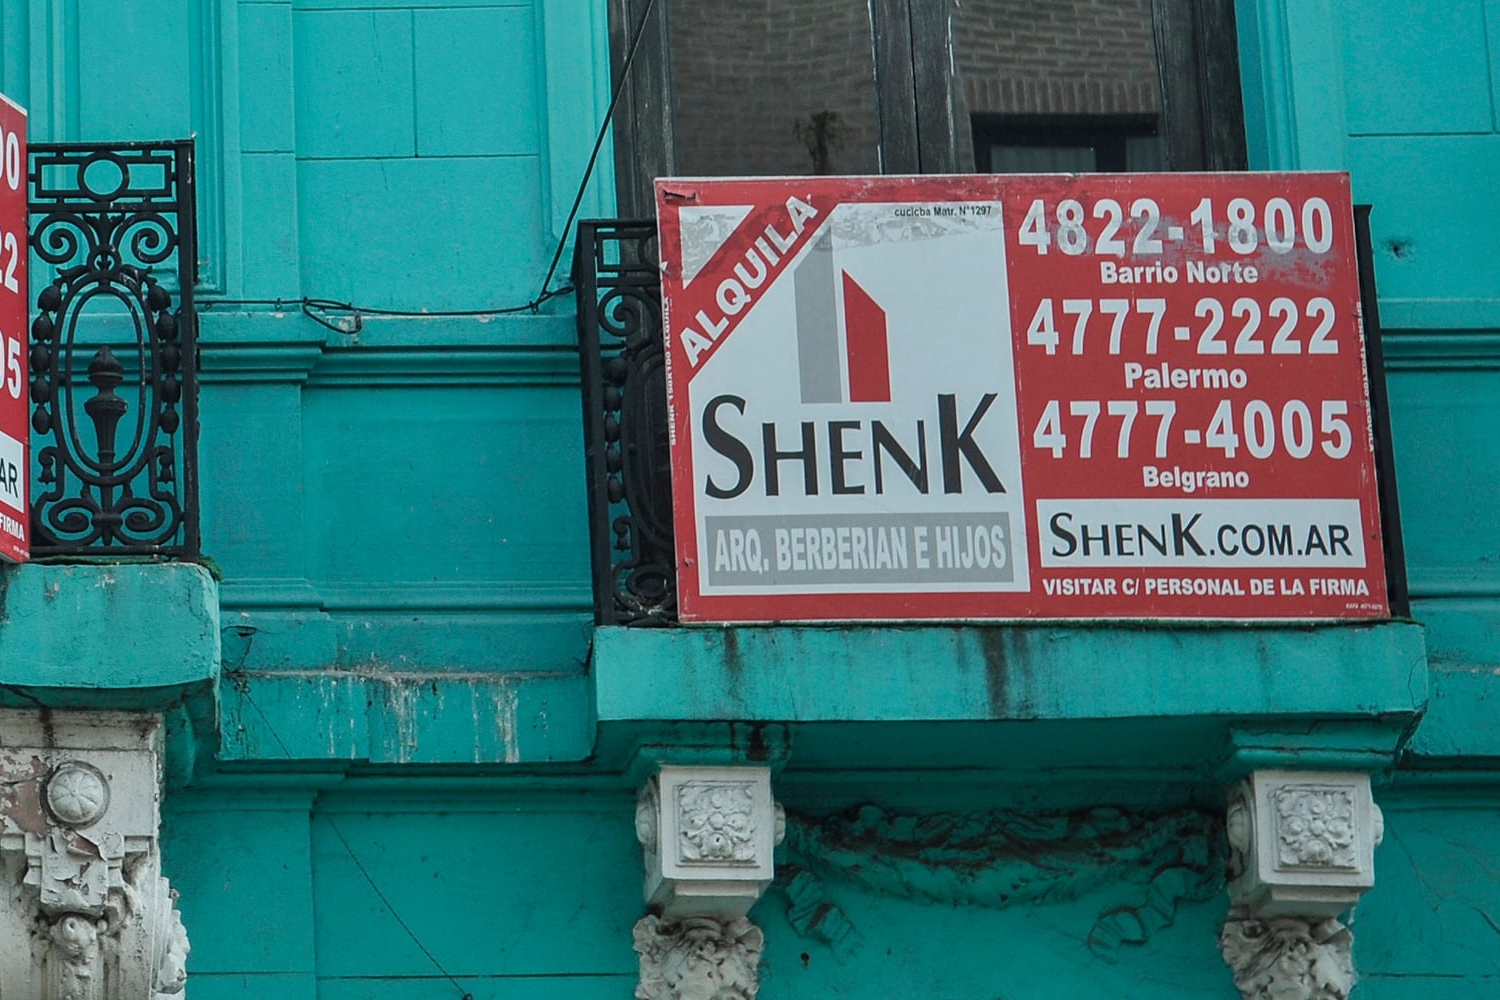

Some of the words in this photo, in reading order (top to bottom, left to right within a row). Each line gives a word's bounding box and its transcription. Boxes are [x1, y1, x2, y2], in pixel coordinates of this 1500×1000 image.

[933, 206, 956, 217] Matr.
[1018, 196, 1333, 256] 4822-1800
[680, 195, 818, 368] ALQUILA
[1100, 261, 1178, 284] Barrio
[1187, 260, 1258, 284] Norte
[1027, 297, 1339, 355] 4777-2222
[1124, 362, 1248, 389] Palermo
[702, 392, 1007, 499] SHENK
[1033, 399, 1353, 459] 4777-4005
[1143, 466, 1250, 492] Belgrano
[714, 528, 769, 575] ARQ.
[775, 526, 909, 571] BERBERIAN
[914, 526, 930, 569] E
[935, 525, 1007, 569] HIJOS
[1049, 511, 1353, 557] SHENK.COM.AR
[1042, 577, 1117, 596] VISITAR
[1122, 577, 1139, 596] C/
[1145, 577, 1245, 596] PERSONAL
[1250, 577, 1277, 596] DE
[1280, 577, 1305, 596] LA
[1310, 577, 1369, 596] FIRMA
